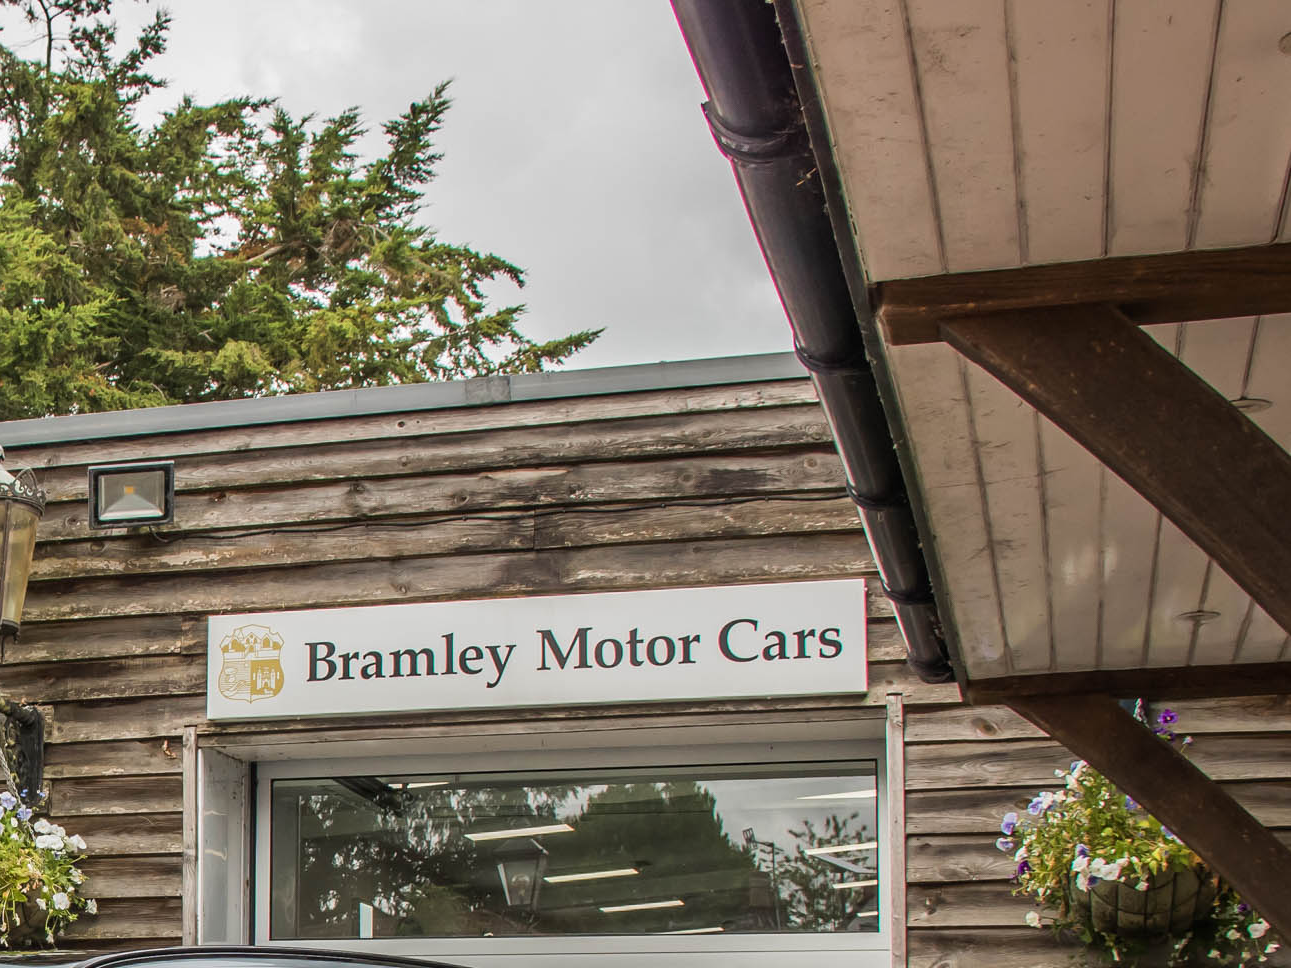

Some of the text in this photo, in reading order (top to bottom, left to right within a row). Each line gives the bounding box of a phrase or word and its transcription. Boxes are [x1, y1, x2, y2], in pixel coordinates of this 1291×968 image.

[305, 618, 843, 689] Bramley Motor Cars
